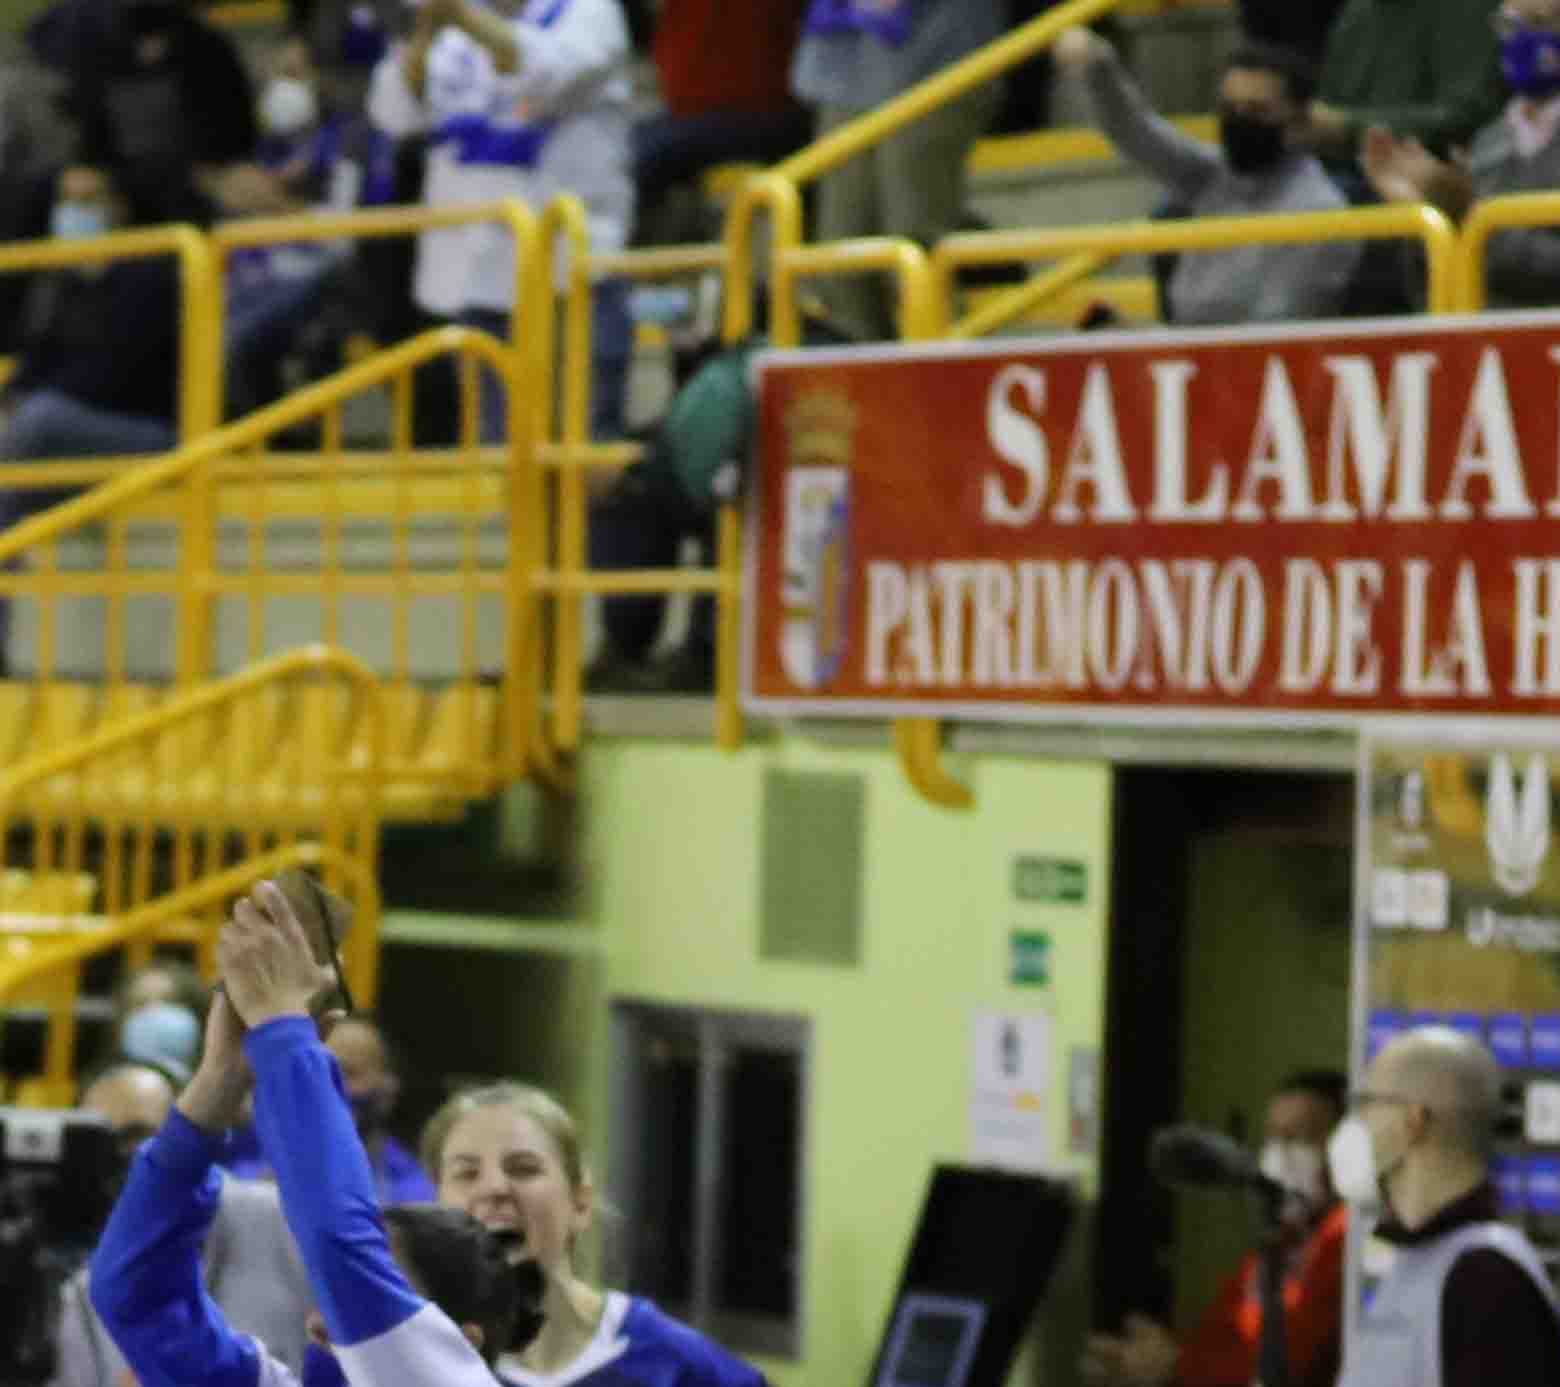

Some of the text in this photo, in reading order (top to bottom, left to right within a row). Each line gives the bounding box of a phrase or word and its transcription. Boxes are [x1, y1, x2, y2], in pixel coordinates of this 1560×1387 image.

[866, 558, 1264, 688] PATRIMONIO
[1280, 558, 1380, 693] DE
[1402, 558, 1488, 695] LA
